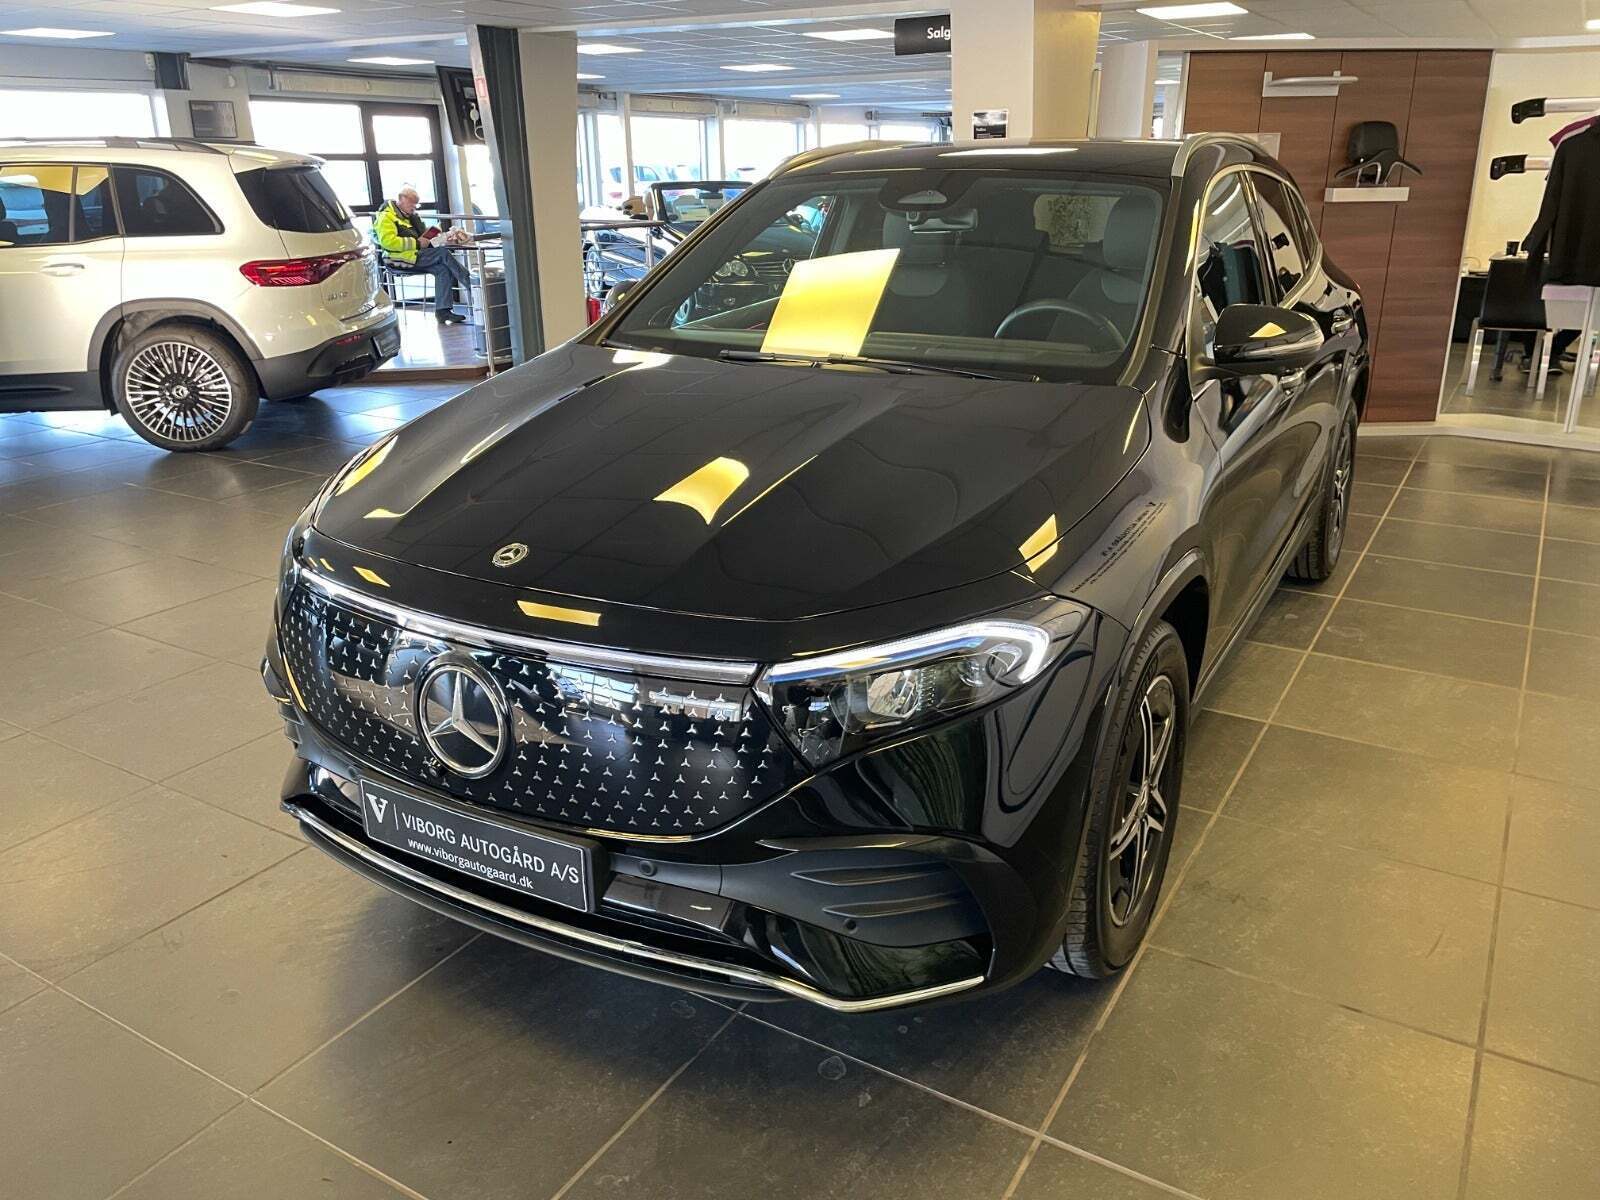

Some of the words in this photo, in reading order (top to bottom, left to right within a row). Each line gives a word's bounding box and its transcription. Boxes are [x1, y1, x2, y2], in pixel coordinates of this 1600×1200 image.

[927, 26, 951, 40] Salg
[402, 812, 456, 844] VIBORG
[460, 833, 545, 873] AUTOGÅRD
[550, 862, 579, 884] A/S
[407, 838, 535, 889] www.viborgautogaard.dk
